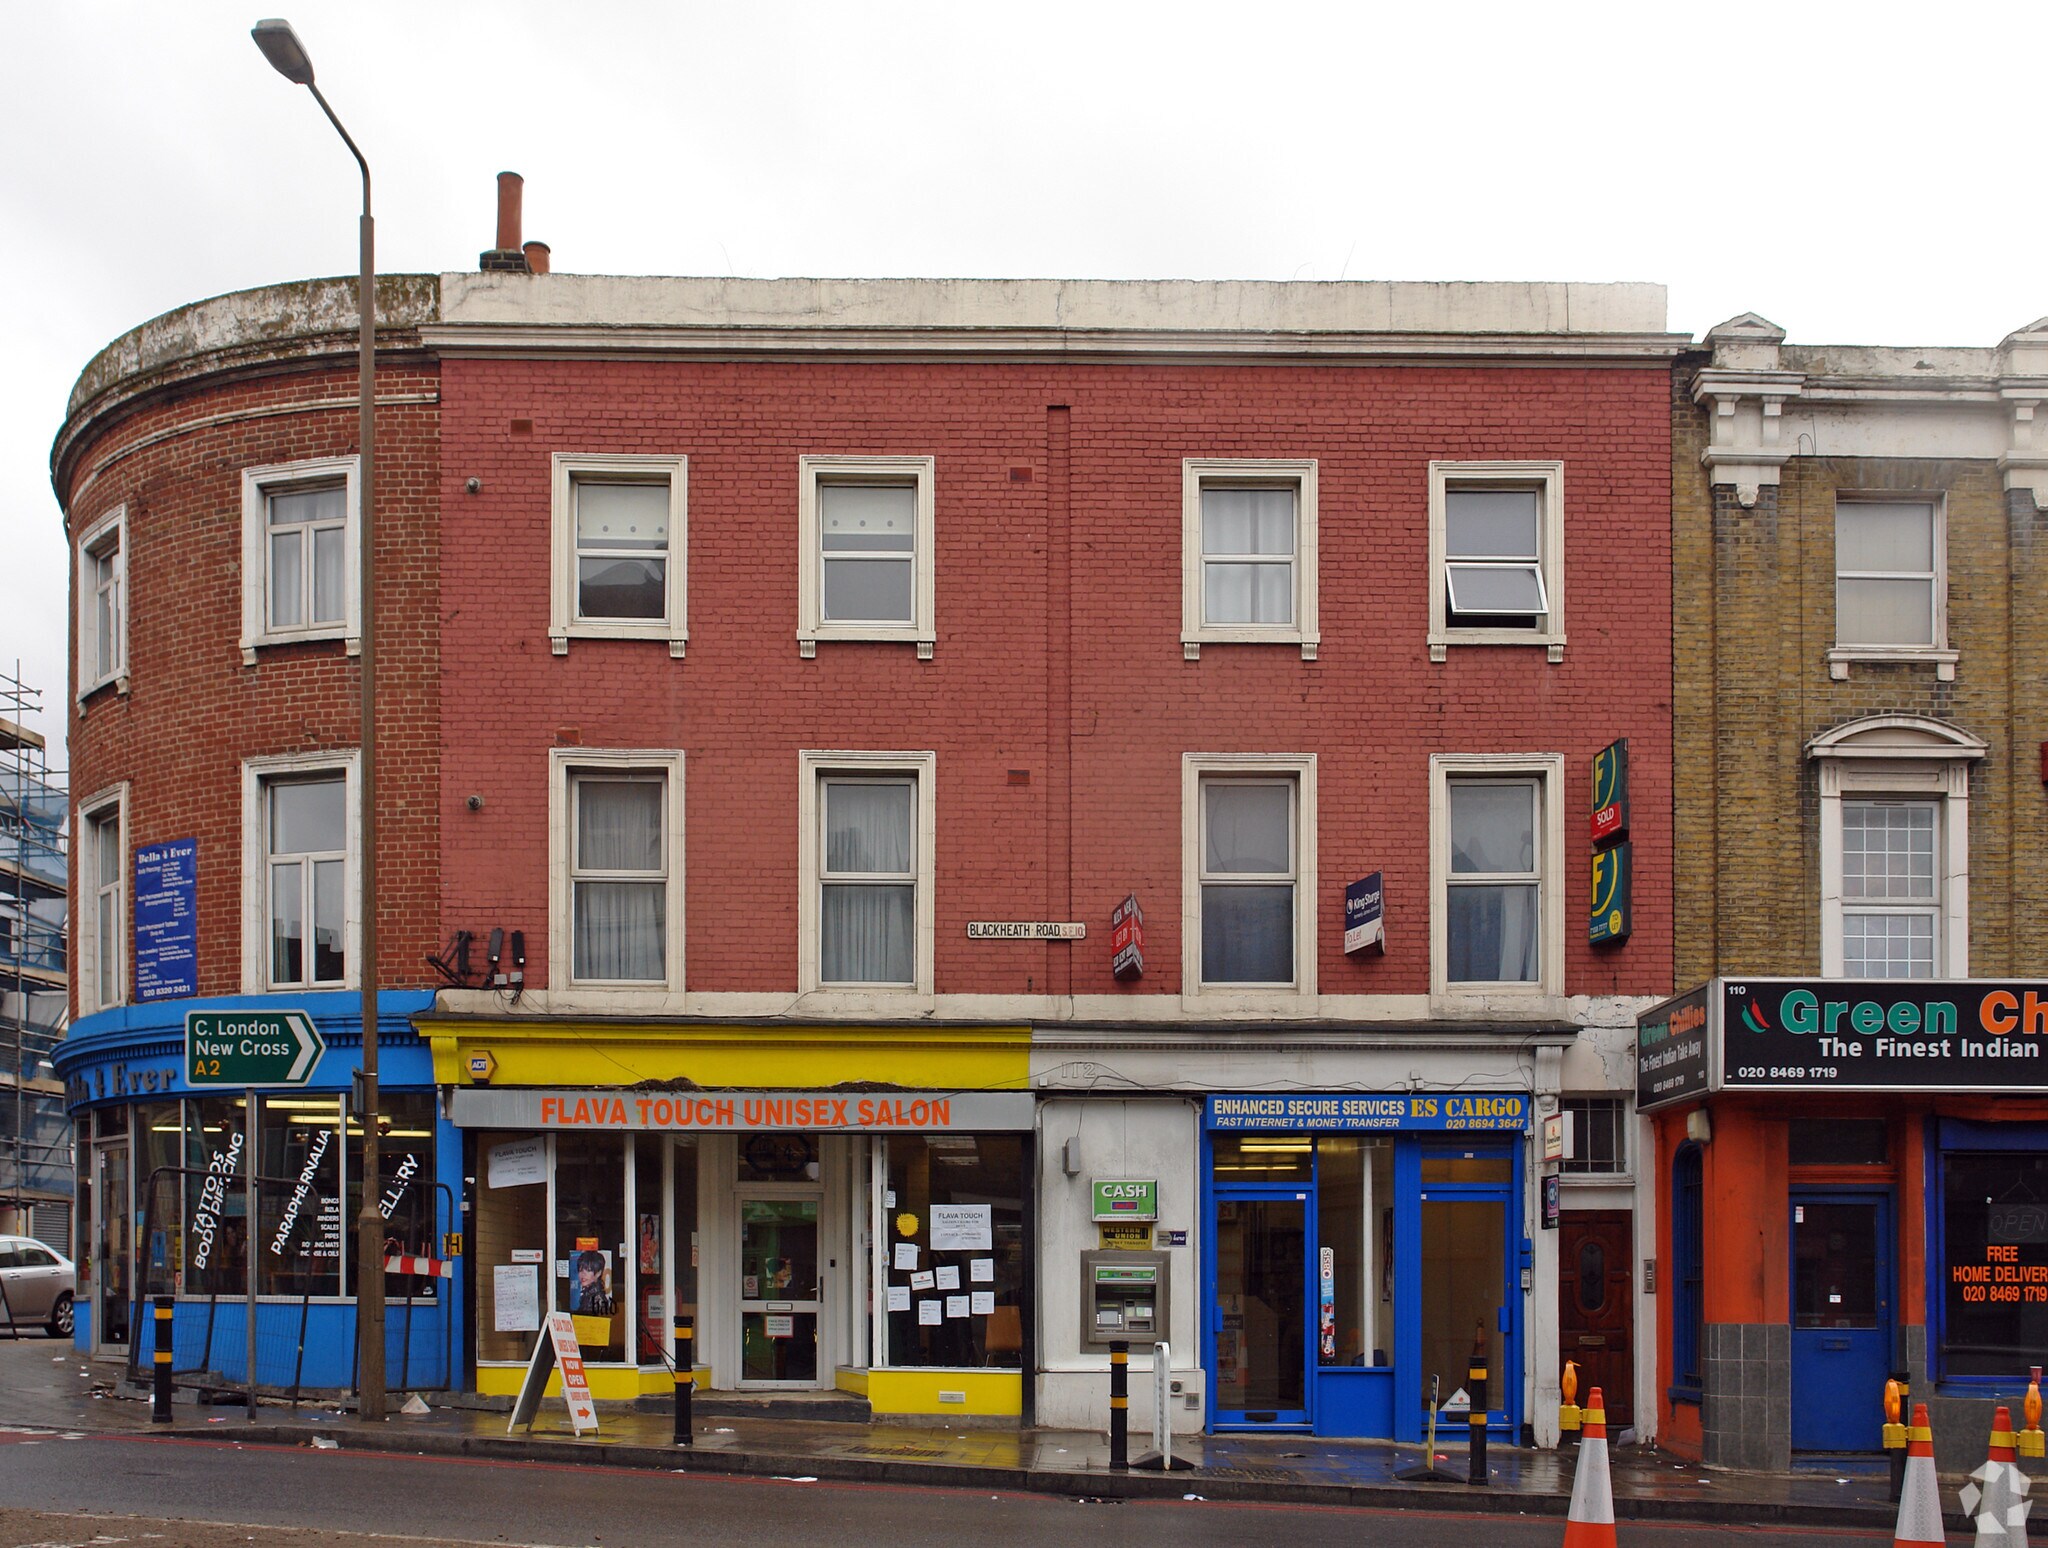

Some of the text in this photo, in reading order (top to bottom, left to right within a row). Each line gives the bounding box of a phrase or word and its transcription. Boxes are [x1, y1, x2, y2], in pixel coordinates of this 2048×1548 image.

[1594, 752, 1605, 804] F
[1597, 808, 1614, 825] SOLD
[138, 852, 160, 864] Bella
[170, 848, 192, 858] Ever
[1592, 853, 1606, 904] F
[1354, 898, 1364, 910] King
[970, 924, 1030, 936] BLACKHEATH
[1346, 932, 1352, 944] To
[144, 989, 155, 997] 020
[174, 985, 190, 993] 2421
[1729, 986, 1746, 995] 110
[1780, 989, 1958, 1035] Green
[195, 1020, 279, 1036] C. London
[1641, 1005, 1705, 1047] Green Chillies
[196, 1040, 289, 1056] New Cross
[1649, 1052, 1662, 1071] Finest
[1663, 1047, 1676, 1066] Indian
[1677, 1042, 1687, 1061] Take
[1689, 1040, 1701, 1058] Away
[1819, 1038, 2039, 1057] The Finest Indian
[194, 1060, 220, 1076] A2
[472, 1061, 486, 1069] ADT
[1062, 1062, 1095, 1078] 112
[1738, 1068, 1837, 1078] 020 8469 1719
[112, 1061, 176, 1095] Ever
[541, 1098, 950, 1126] FLAVA TOUCH UNISEX SALON
[1214, 1098, 1522, 1117] ENHANCED SECURE SERVICES ES CARGO
[1216, 1117, 1524, 1129] FAST INTERNET & MONEY TRANSFER 020 8694 3647
[192, 1150, 224, 1235] TATTOOS
[270, 1130, 332, 1255] PARAPHERNALIA
[1101, 1185, 1148, 1198] CASH
[1990, 1215, 2047, 1232] OPEN
[194, 1212, 217, 1270] BODY
[1987, 1246, 2018, 1262] FREE
[1320, 1249, 1332, 1279] Oasis
[1953, 1266, 1991, 1282] HOME
[1963, 1286, 2047, 1302] 020 8469 1719
[566, 1360, 579, 1370] NOW
[568, 1374, 585, 1385] OPEN
